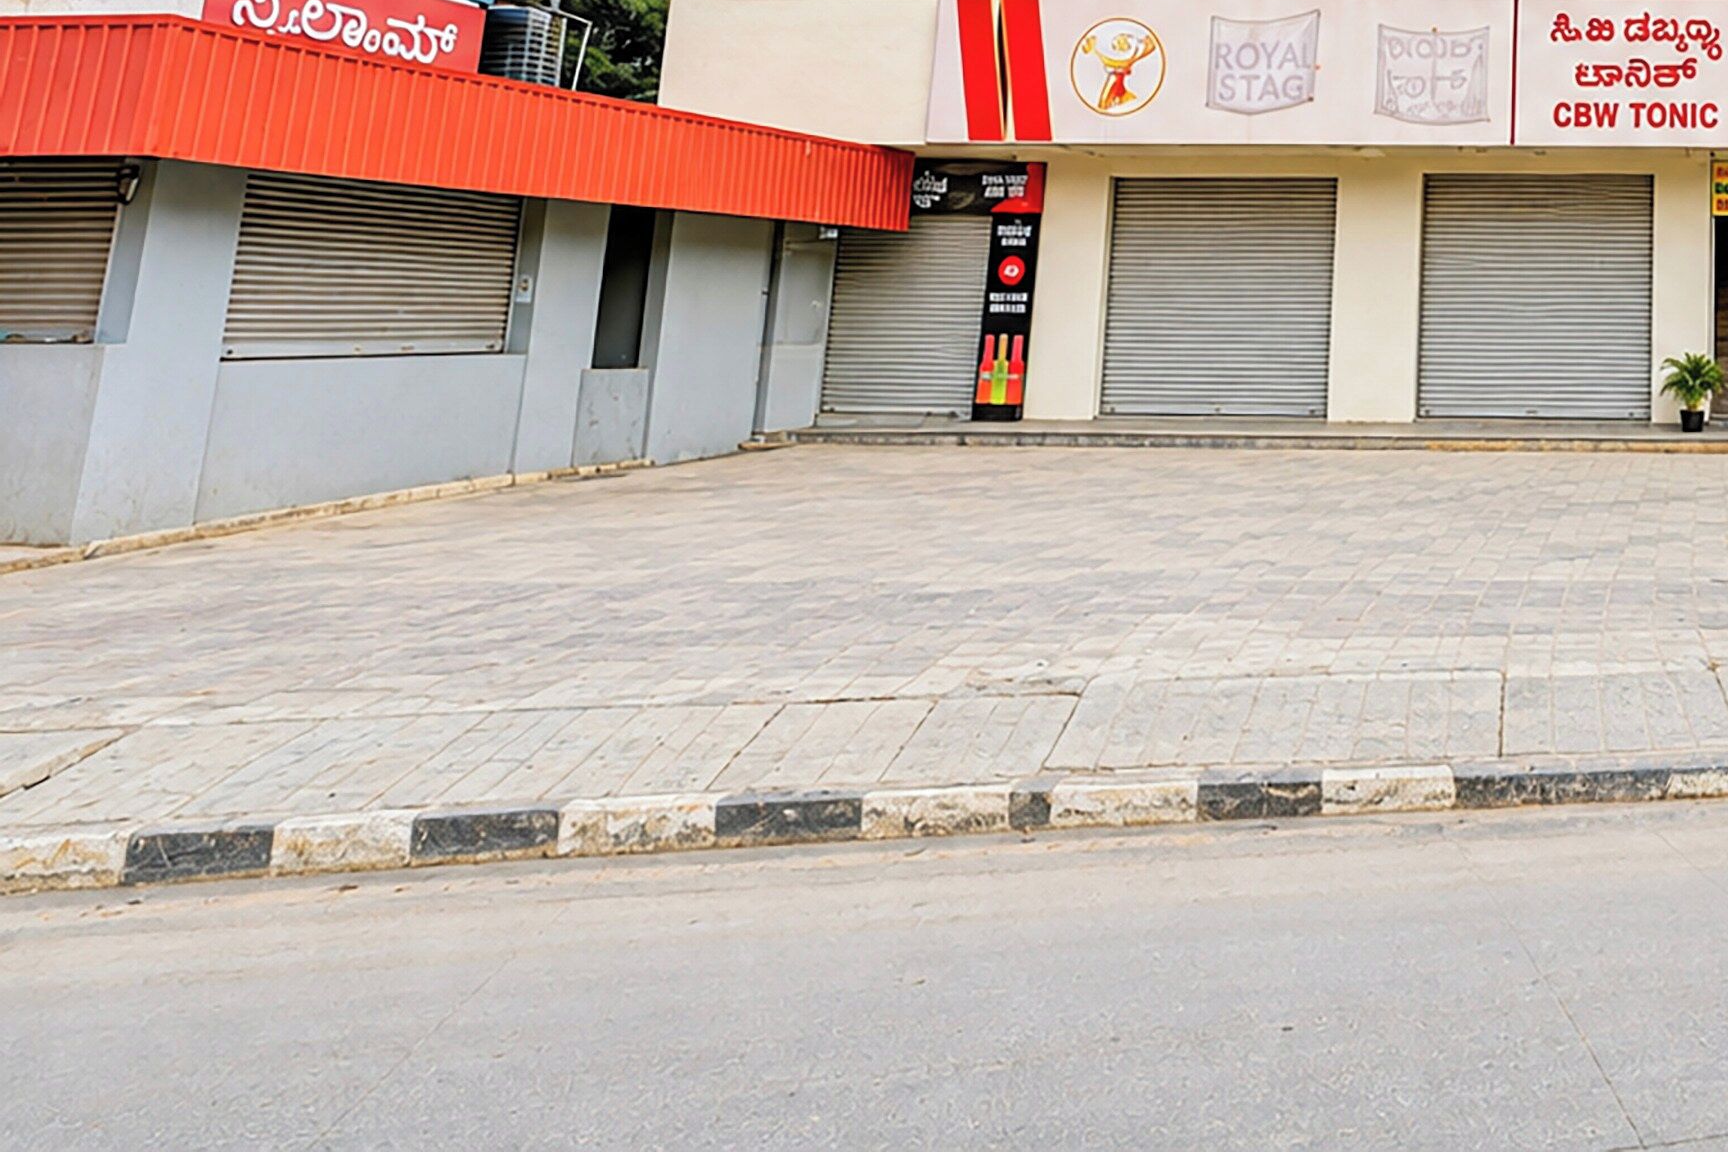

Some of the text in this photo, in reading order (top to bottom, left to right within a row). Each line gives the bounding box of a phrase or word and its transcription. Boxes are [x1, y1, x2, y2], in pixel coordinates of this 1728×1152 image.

[1215, 42, 1311, 70] ROYAL
[1218, 74, 1305, 102] STAG
[1553, 102, 1719, 129] CBW TONIC
